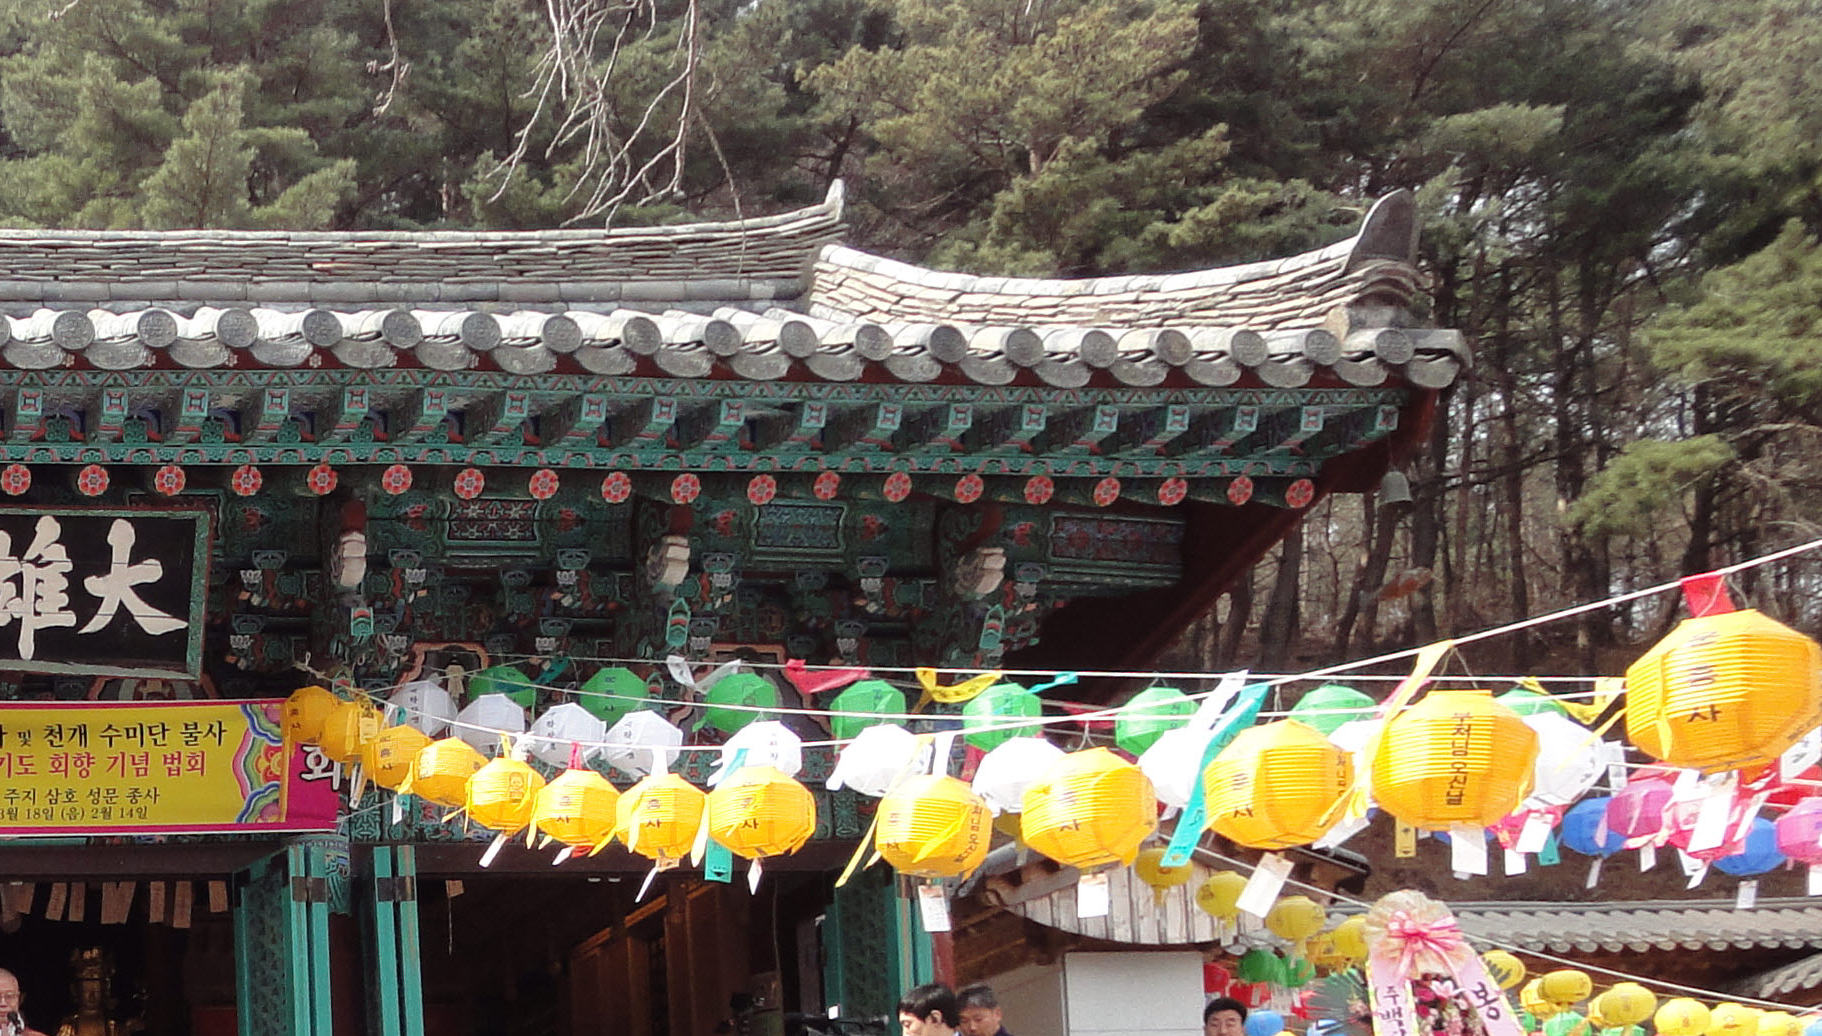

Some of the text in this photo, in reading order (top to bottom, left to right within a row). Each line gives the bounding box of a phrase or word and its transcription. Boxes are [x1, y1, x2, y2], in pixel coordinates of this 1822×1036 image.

[17, 729, 32, 748] 및
[43, 723, 89, 749] 천개
[98, 722, 171, 749] 수미단
[179, 720, 228, 748] 불사
[48, 750, 96, 779] 회향
[105, 750, 151, 778] 기념
[162, 749, 207, 778] 법회
[3, 787, 37, 806] 주지
[86, 786, 120, 806] 성문
[125, 786, 161, 805] 종사
[25, 806, 54, 821] 18일
[90, 805, 113, 820] 2월
[119, 805, 148, 820] 14일
